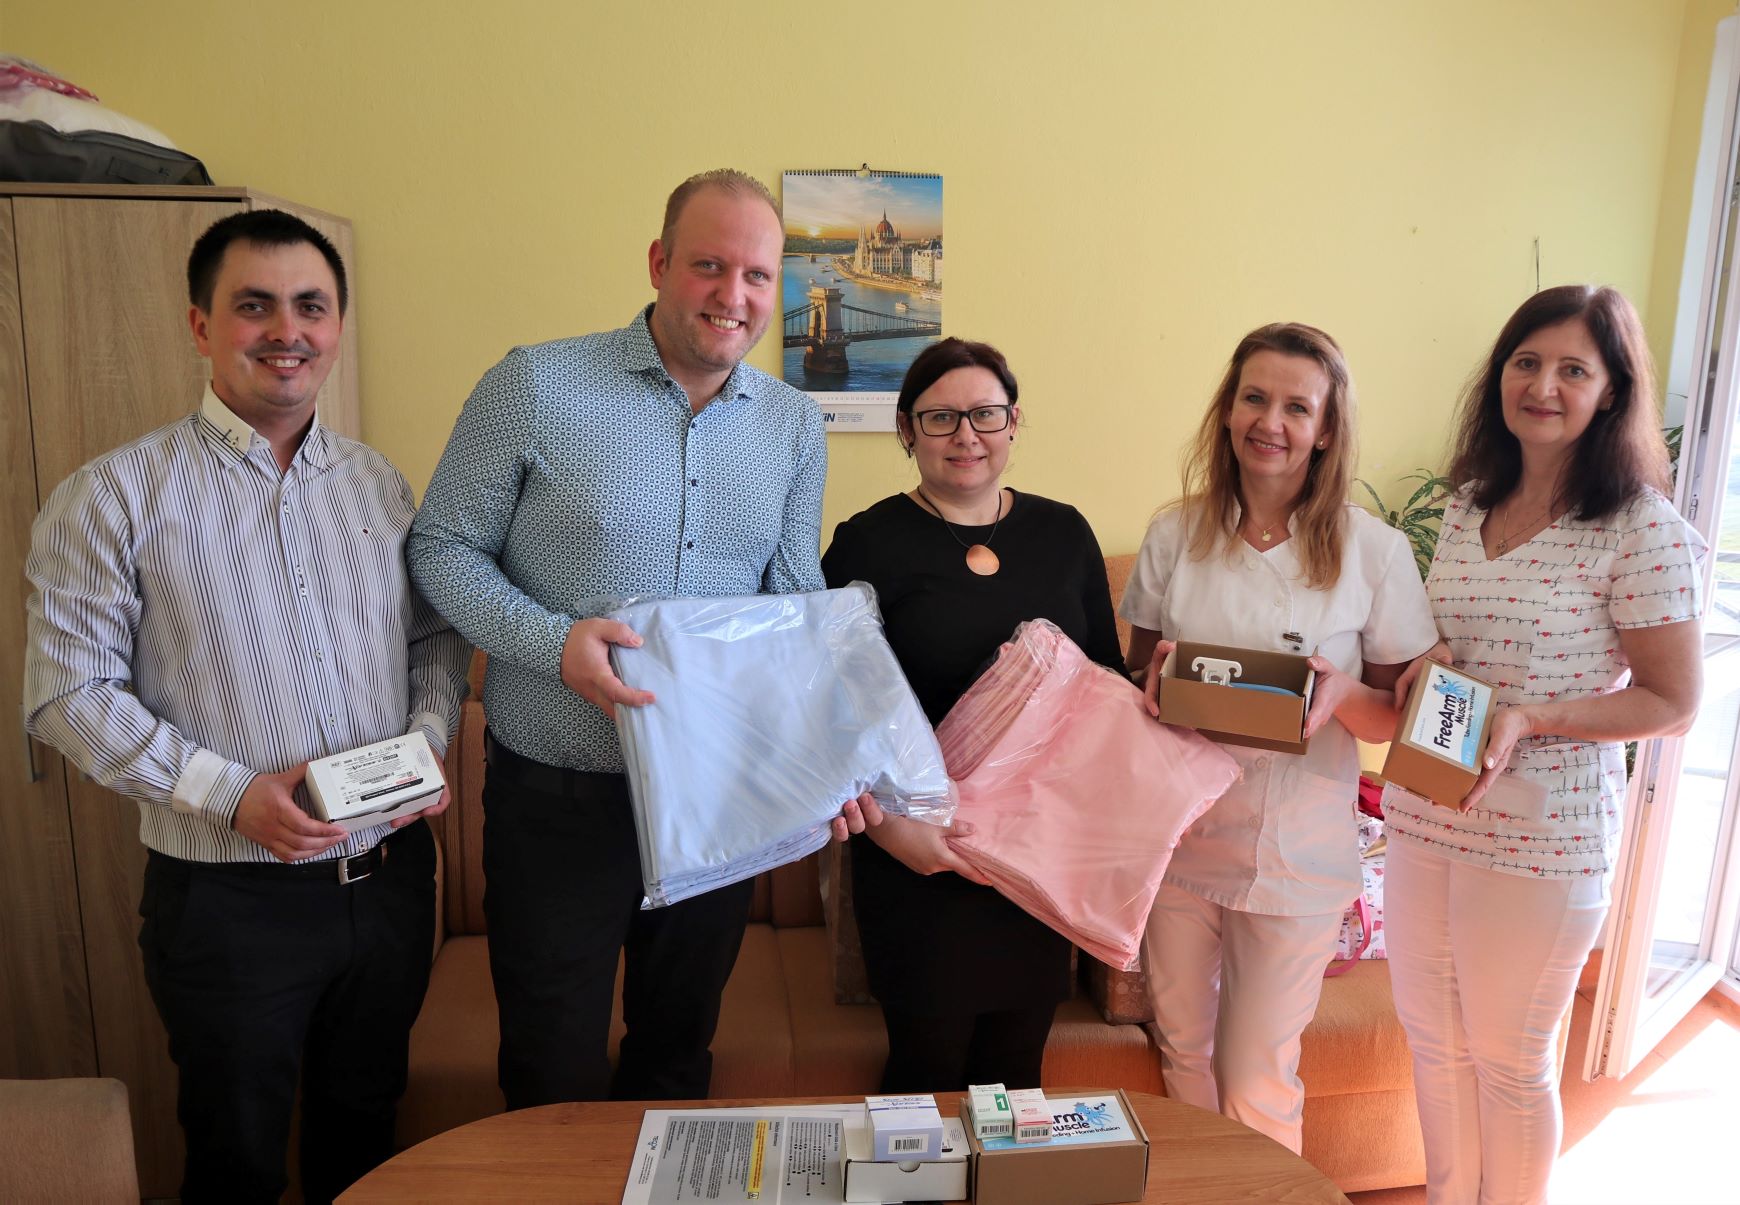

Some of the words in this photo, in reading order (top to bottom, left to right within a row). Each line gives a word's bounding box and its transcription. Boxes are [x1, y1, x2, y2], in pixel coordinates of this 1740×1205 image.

[1455, 698, 1467, 725] Muscle
[1434, 695, 1456, 749] FreeArm
[997, 1098, 1006, 1109] 1
[1053, 1113, 1084, 1124] rm
